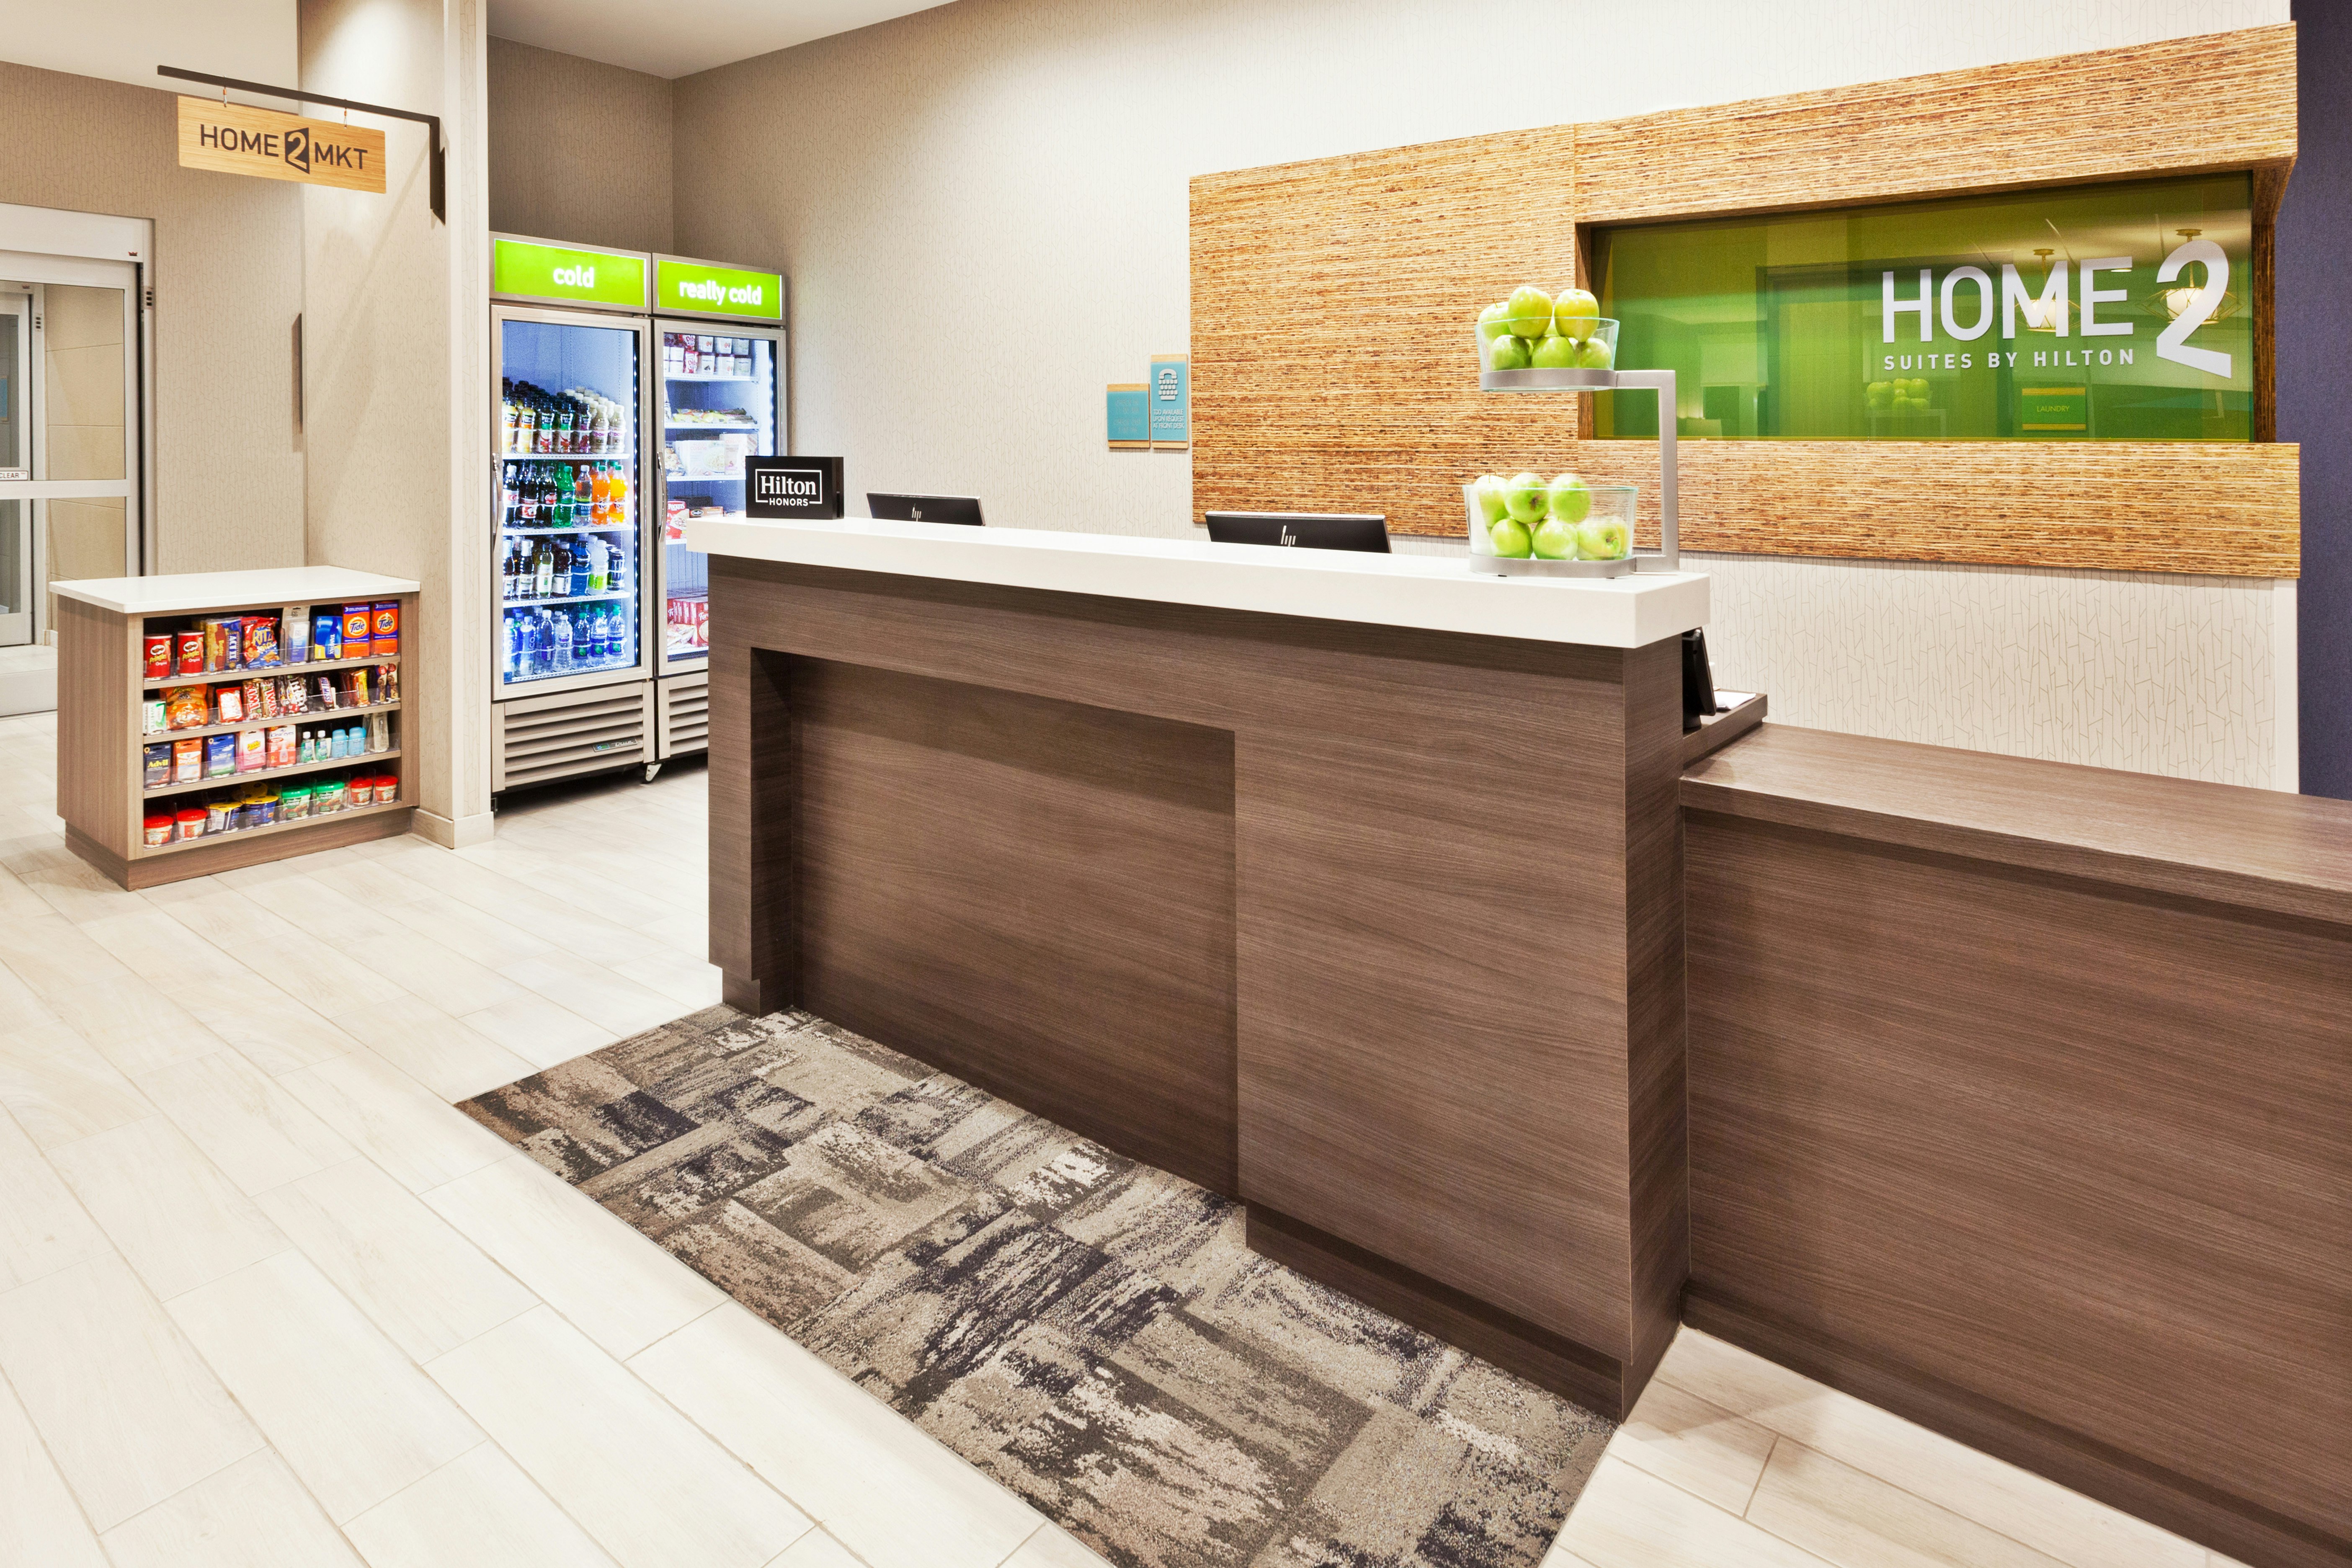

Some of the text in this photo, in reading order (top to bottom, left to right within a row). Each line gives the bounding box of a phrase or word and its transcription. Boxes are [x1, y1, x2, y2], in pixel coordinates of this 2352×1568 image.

[200, 124, 368, 170] HOME 2 MKT
[553, 265, 594, 288] cold
[679, 281, 762, 305] really cold
[1882, 240, 2232, 379] HOME 2
[1883, 348, 2135, 371] SUITES BY HILTON
[2036, 405, 2070, 414] LAUNDRY
[761, 475, 817, 495] Hilton
[769, 497, 809, 507] HONORS
[350, 622, 365, 633] Tide
[379, 619, 393, 629] Tide
[149, 653, 167, 665] Pringles
[182, 650, 200, 661] Pringles
[248, 684, 261, 714] TWIX
[266, 687, 277, 717] TWIX
[147, 759, 169, 768] Advil
